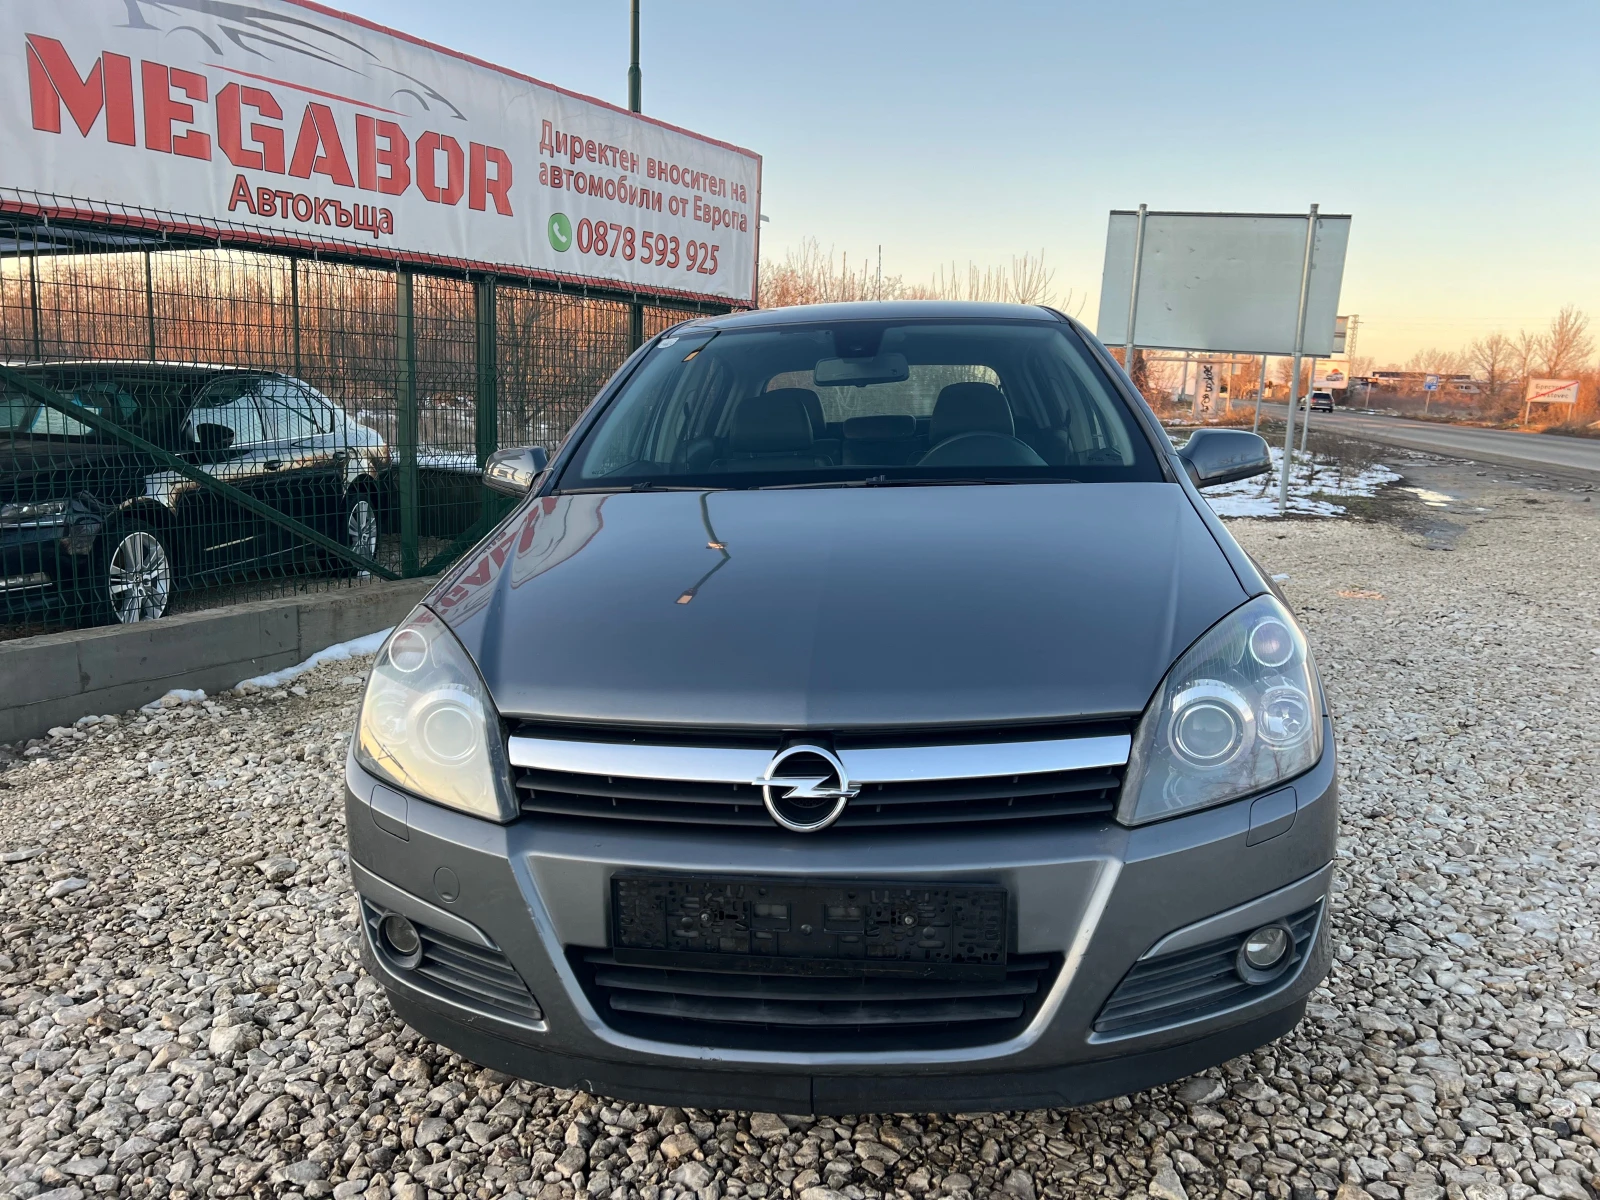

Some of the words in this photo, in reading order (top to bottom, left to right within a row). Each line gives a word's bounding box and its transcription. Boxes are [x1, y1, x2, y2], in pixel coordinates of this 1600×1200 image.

[25, 33, 513, 216] MEGABOR
[539, 119, 640, 175] Директен
[646, 157, 727, 199] вносител
[730, 181, 747, 204] на
[228, 174, 394, 239] Автокъща
[538, 161, 663, 213] автомобили
[668, 195, 689, 218] от
[693, 194, 748, 233] Европа
[576, 217, 637, 261] 0878
[640, 230, 680, 269] 593
[685, 239, 720, 275] 925
[1535, 383, 1572, 391] Брестоц
